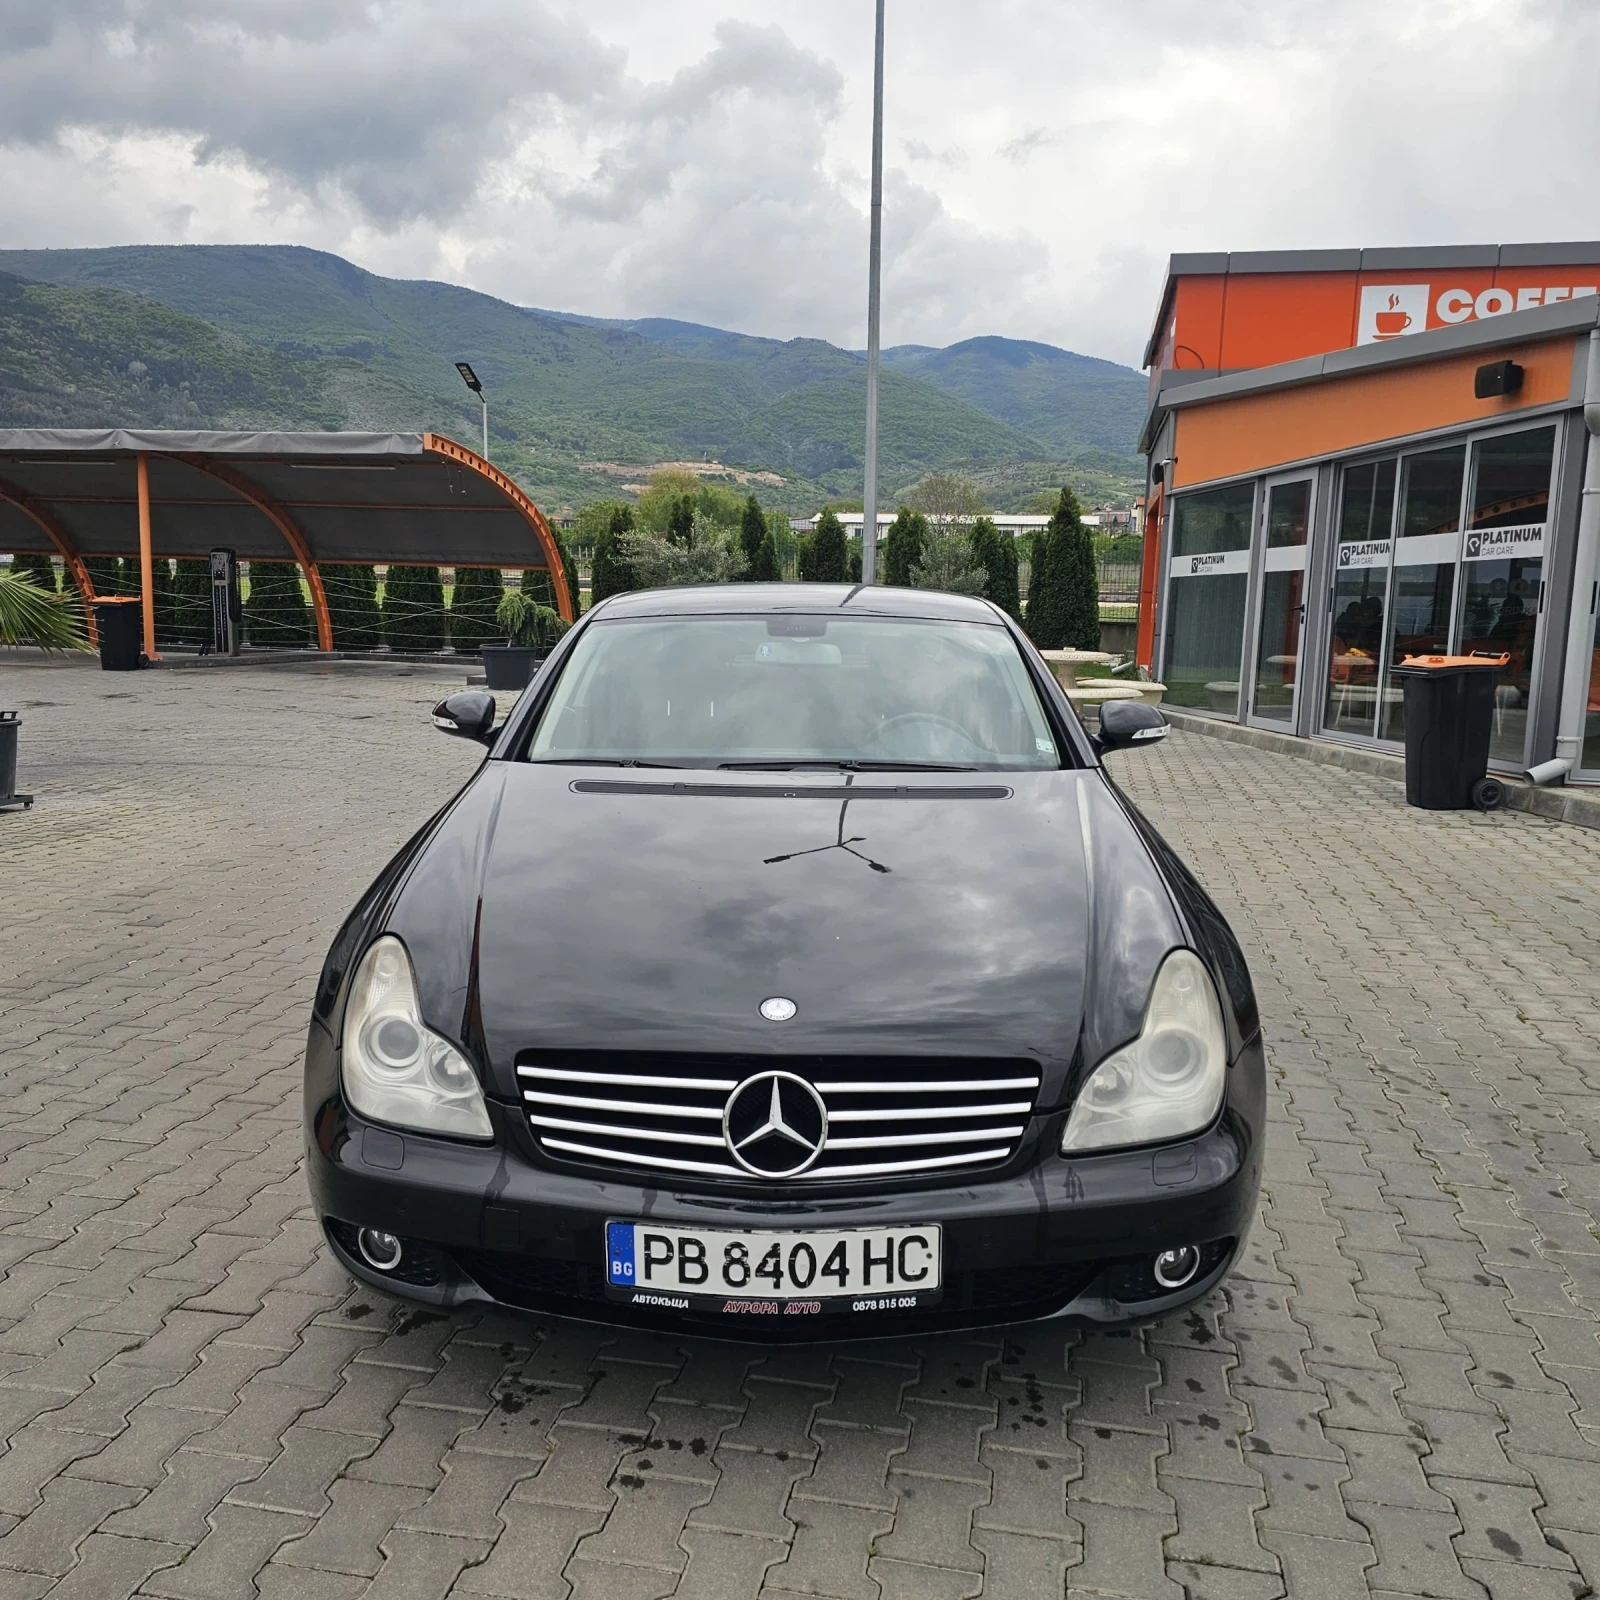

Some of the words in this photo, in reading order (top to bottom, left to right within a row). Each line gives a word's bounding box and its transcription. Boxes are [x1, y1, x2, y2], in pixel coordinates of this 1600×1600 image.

[1482, 527, 1542, 545] PLATINUM
[1481, 547, 1495, 556] CAR
[1496, 545, 1514, 555] CARE
[1198, 555, 1225, 565] PLATINUM
[1350, 557, 1361, 566] CAR
[1361, 556, 1374, 565] CARE
[612, 1260, 633, 1276] BG
[644, 1233, 709, 1285] PB
[722, 1240, 850, 1290] 8404
[863, 1235, 929, 1286] HC
[631, 1293, 689, 1309] АВТОКЪЩА
[722, 1300, 779, 1315] АУРОРА
[783, 1301, 821, 1315] АУТО
[852, 1300, 877, 1311] 0878
[878, 1298, 897, 1309] 815
[898, 1296, 917, 1308] 005
